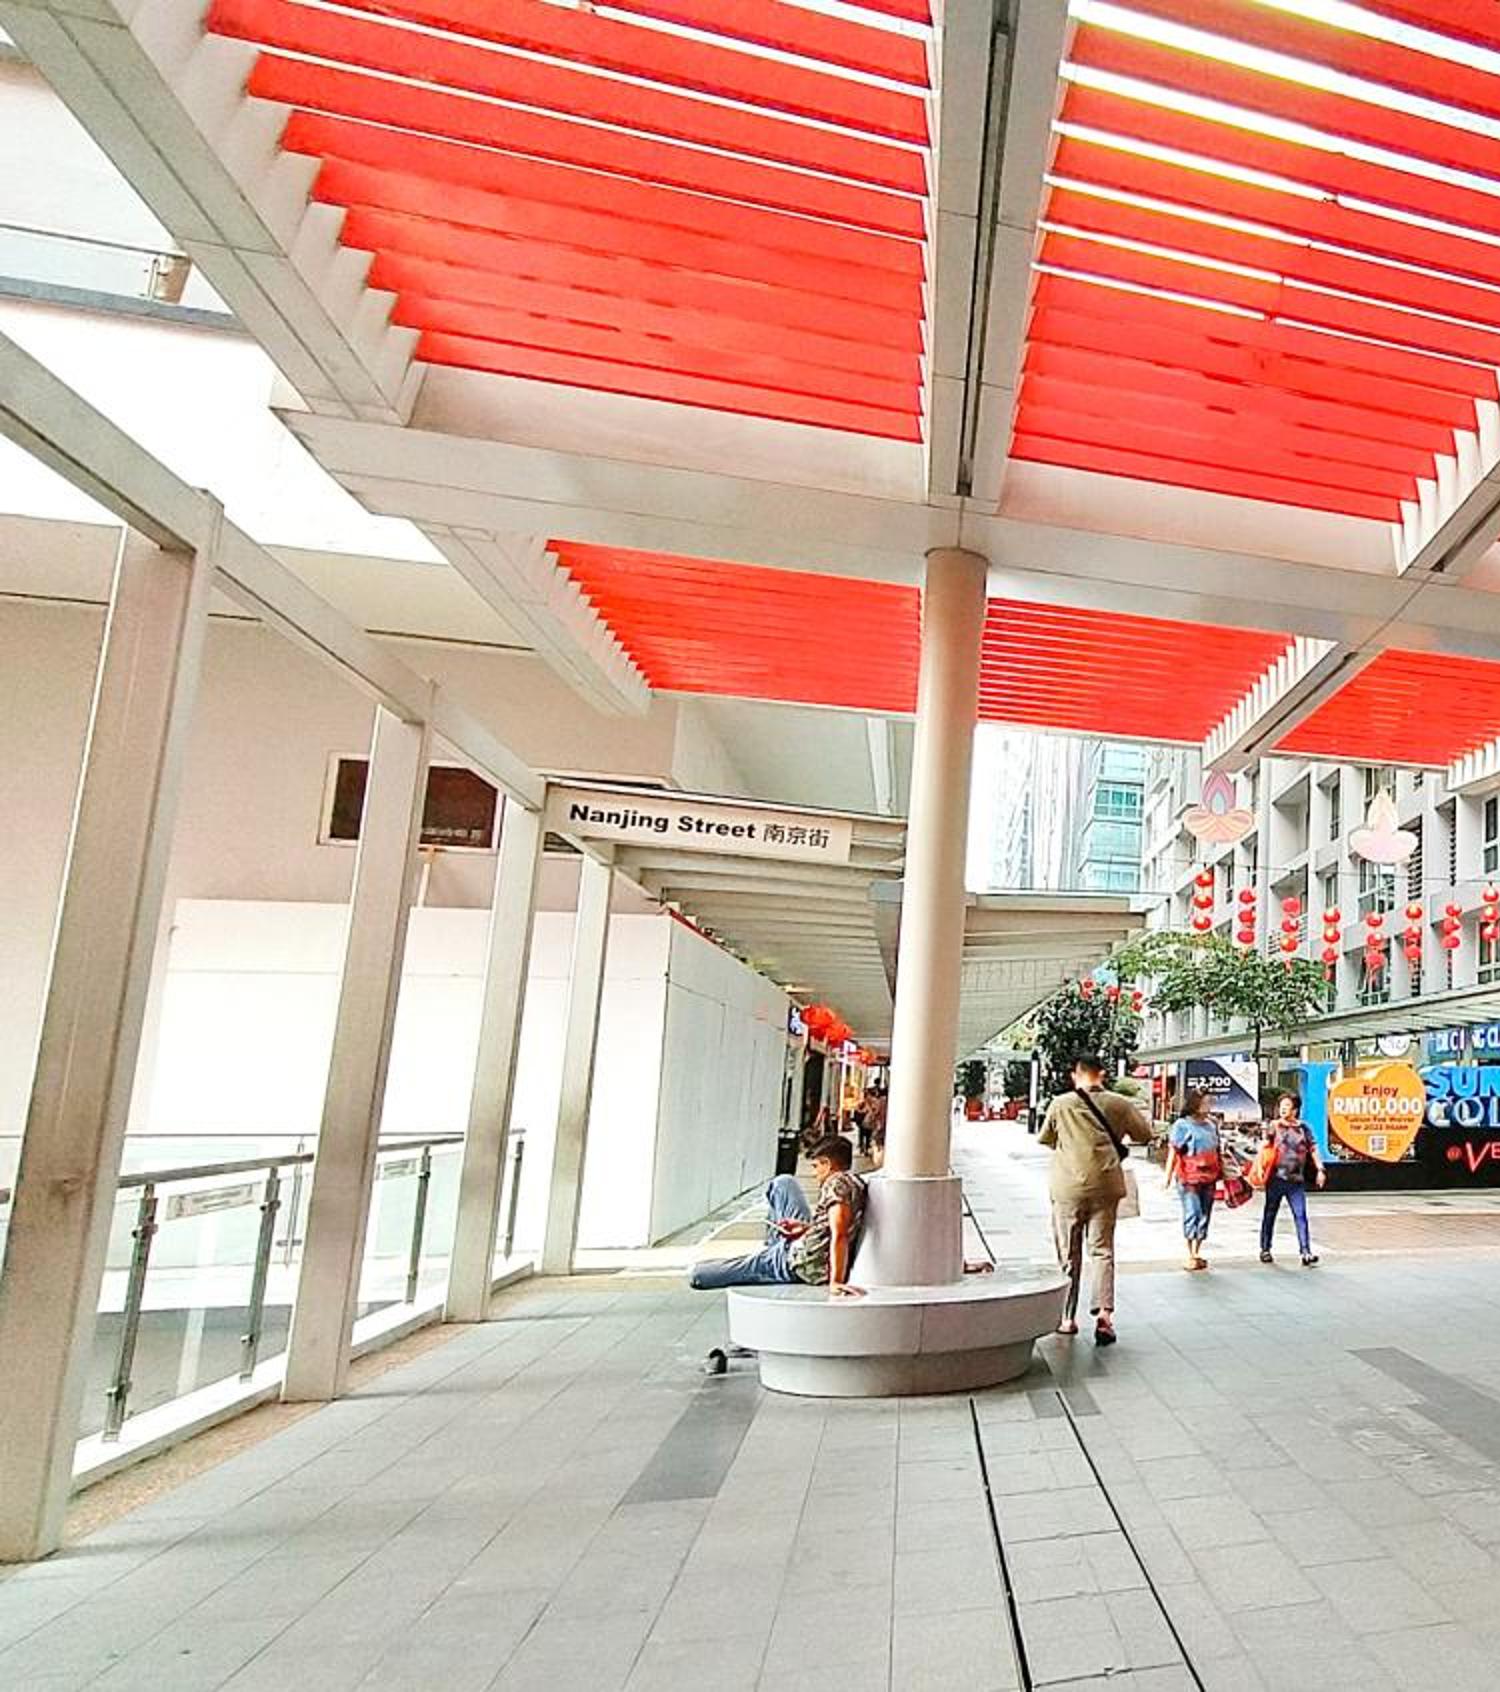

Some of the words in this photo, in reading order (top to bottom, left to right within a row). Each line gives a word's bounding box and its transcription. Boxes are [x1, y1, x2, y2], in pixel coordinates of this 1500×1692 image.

[570, 804, 668, 832] Nanjing
[677, 815, 756, 839] Street
[763, 823, 829, 848] 南京街
[1363, 1084, 1399, 1097] Enjoy
[1333, 1097, 1422, 1115] RM10,000
